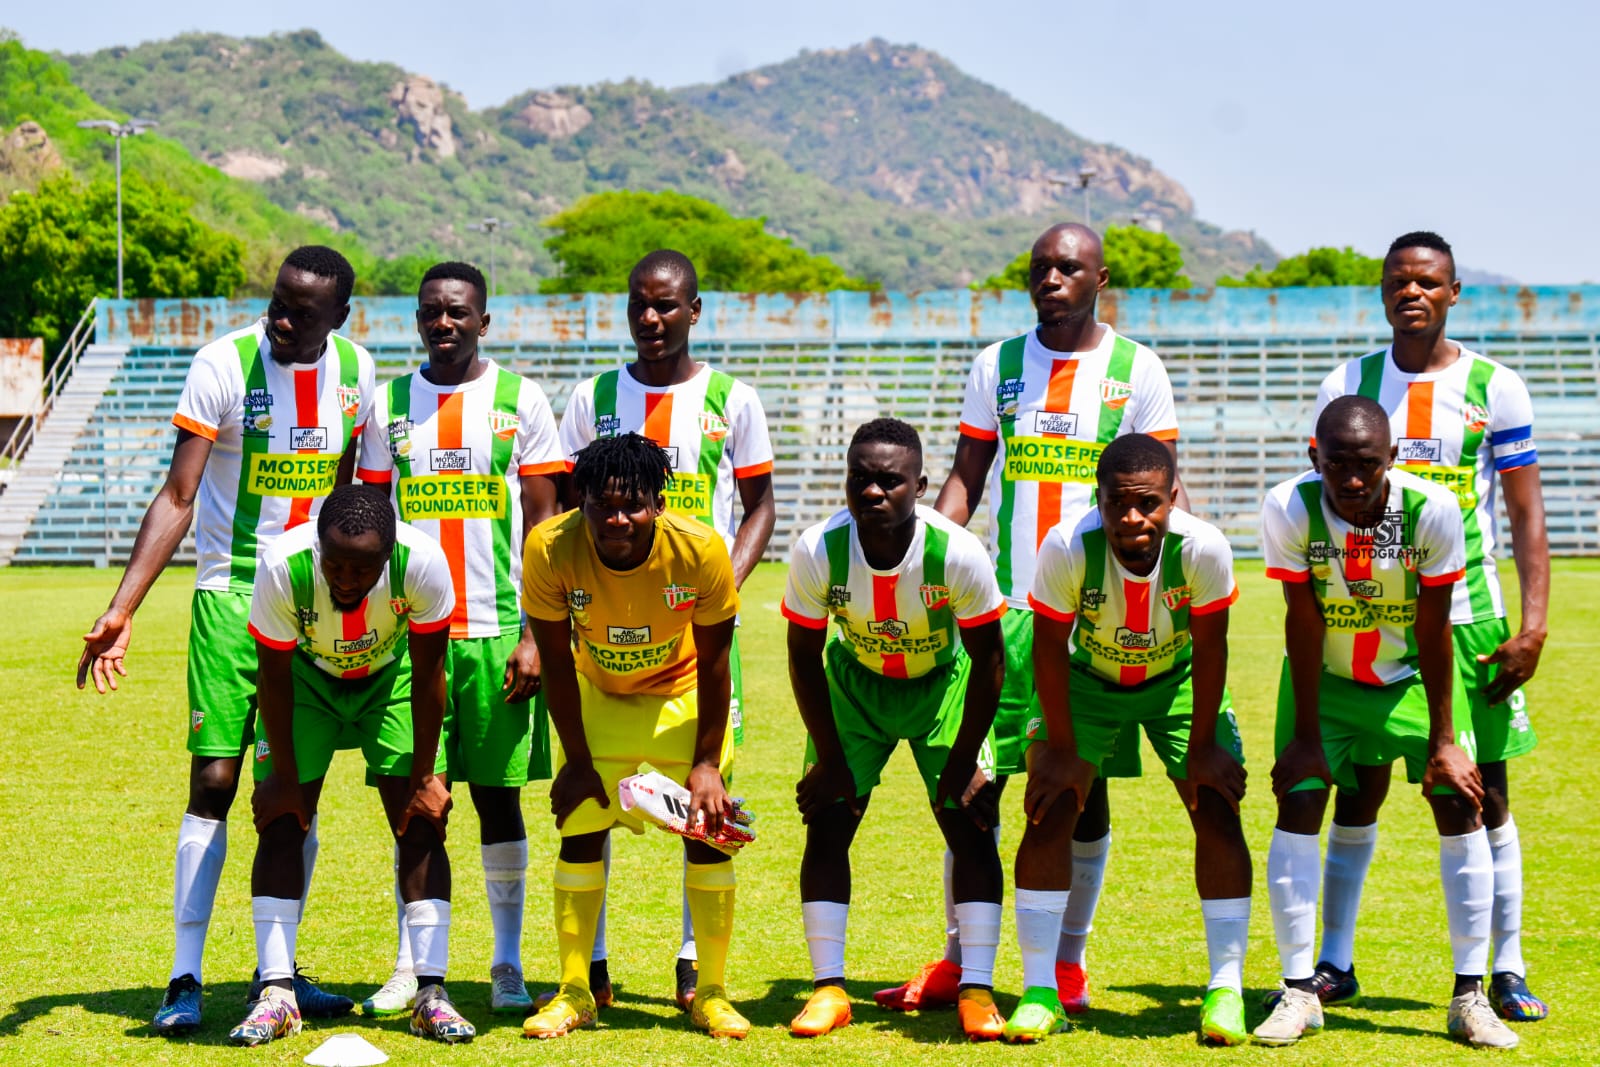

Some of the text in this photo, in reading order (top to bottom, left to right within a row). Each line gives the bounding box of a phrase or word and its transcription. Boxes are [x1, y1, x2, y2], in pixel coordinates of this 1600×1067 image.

[1040, 420, 1073, 428] MOTSEPE
[1042, 425, 1070, 433] LEAGUE
[1009, 443, 1101, 462] MOTSEPE
[1405, 451, 1435, 459] LEAGUE
[257, 459, 340, 474] MOTSEPE
[406, 481, 499, 496] MOTSEPE
[405, 499, 498, 514] FOUNDATION
[585, 637, 678, 661] MOTSEPE
[1085, 634, 1184, 659] MOTSEPE
